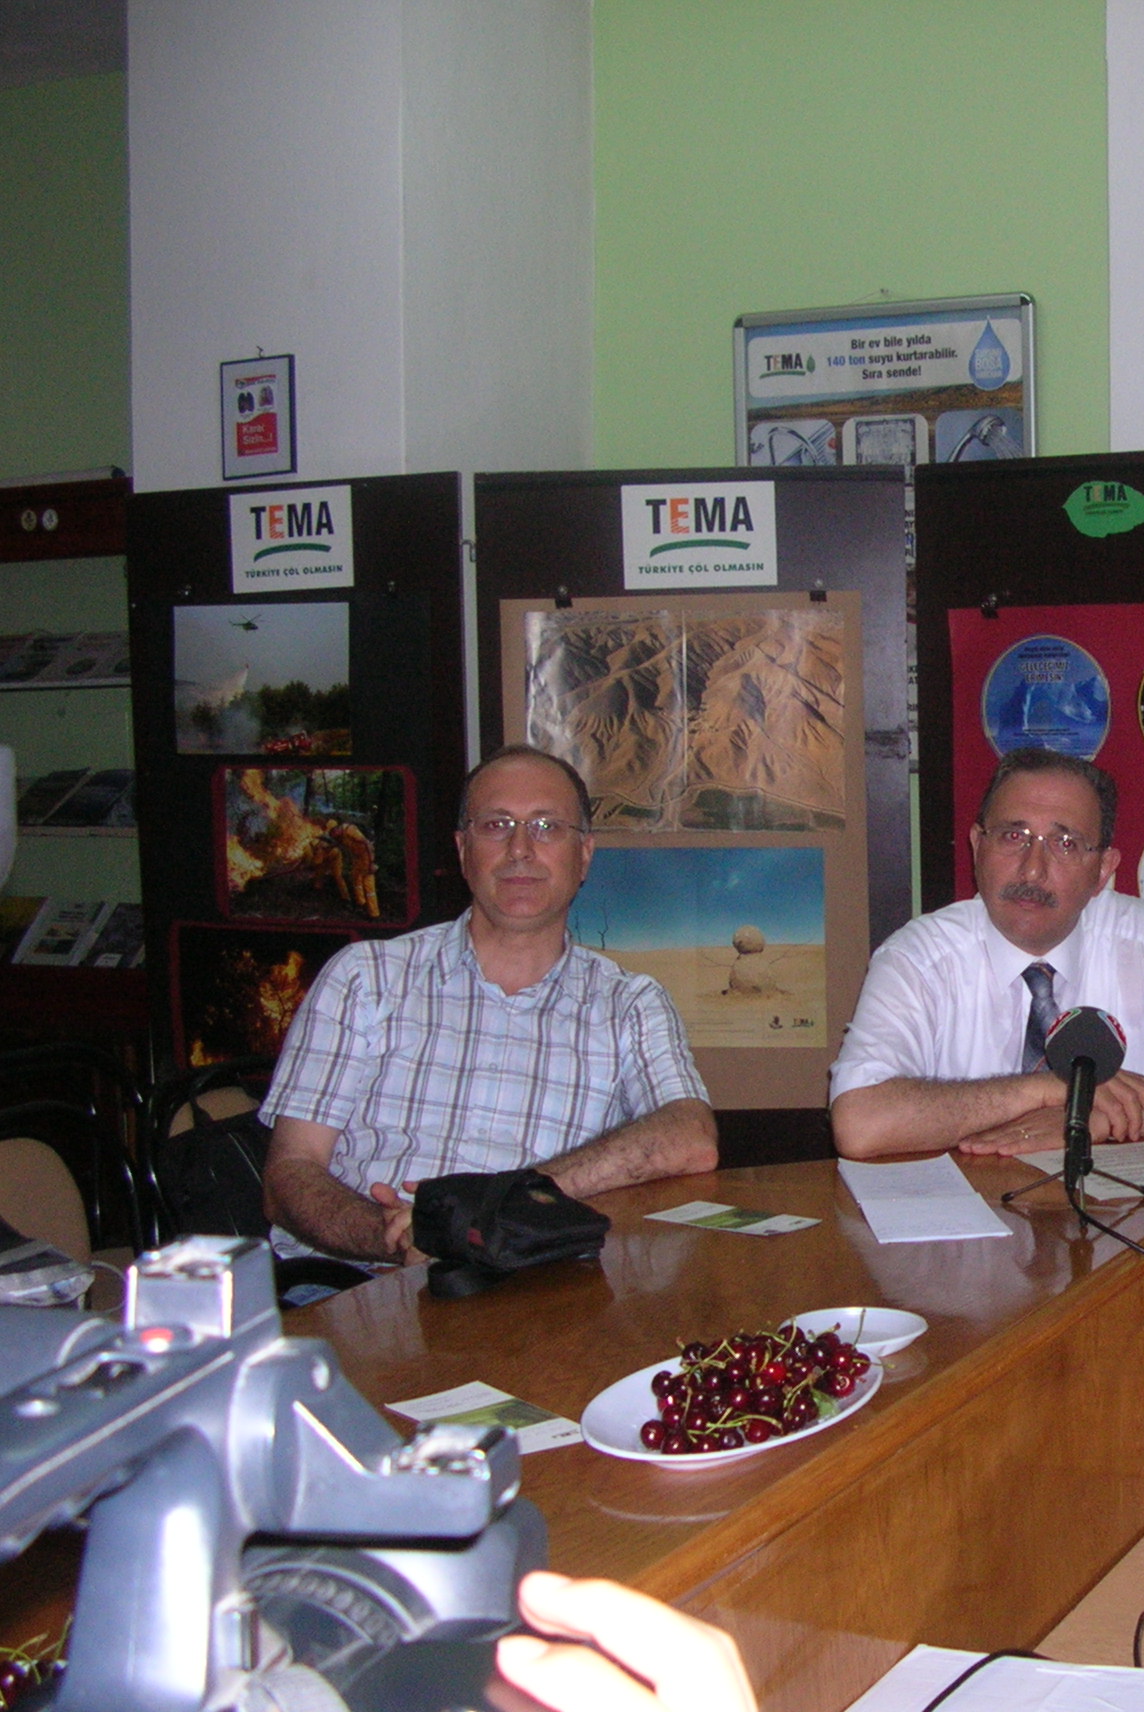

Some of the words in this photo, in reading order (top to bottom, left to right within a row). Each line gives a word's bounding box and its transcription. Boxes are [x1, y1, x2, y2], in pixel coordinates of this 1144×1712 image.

[851, 338, 866, 350] Bir
[868, 340, 881, 349] ev
[883, 336, 902, 347] bile
[906, 334, 931, 348] yılda
[764, 353, 803, 371] TEMA
[827, 356, 845, 367] 140
[848, 355, 866, 365] ton
[868, 353, 893, 366] suyu
[896, 348, 958, 362] kurtarabilir.
[862, 369, 883, 379] Sıra
[886, 366, 922, 378] sende!
[1083, 485, 1128, 502] TEMA
[250, 501, 334, 540] TEMA
[645, 496, 754, 534] TEMA
[245, 569, 280, 578] TÜRKİYE
[283, 567, 300, 577] ÇÖL
[303, 565, 343, 575] OLMASIN
[638, 563, 684, 574] TÜRKİYE
[688, 563, 709, 575] ÇÖL
[714, 563, 764, 572] OLMASIN
